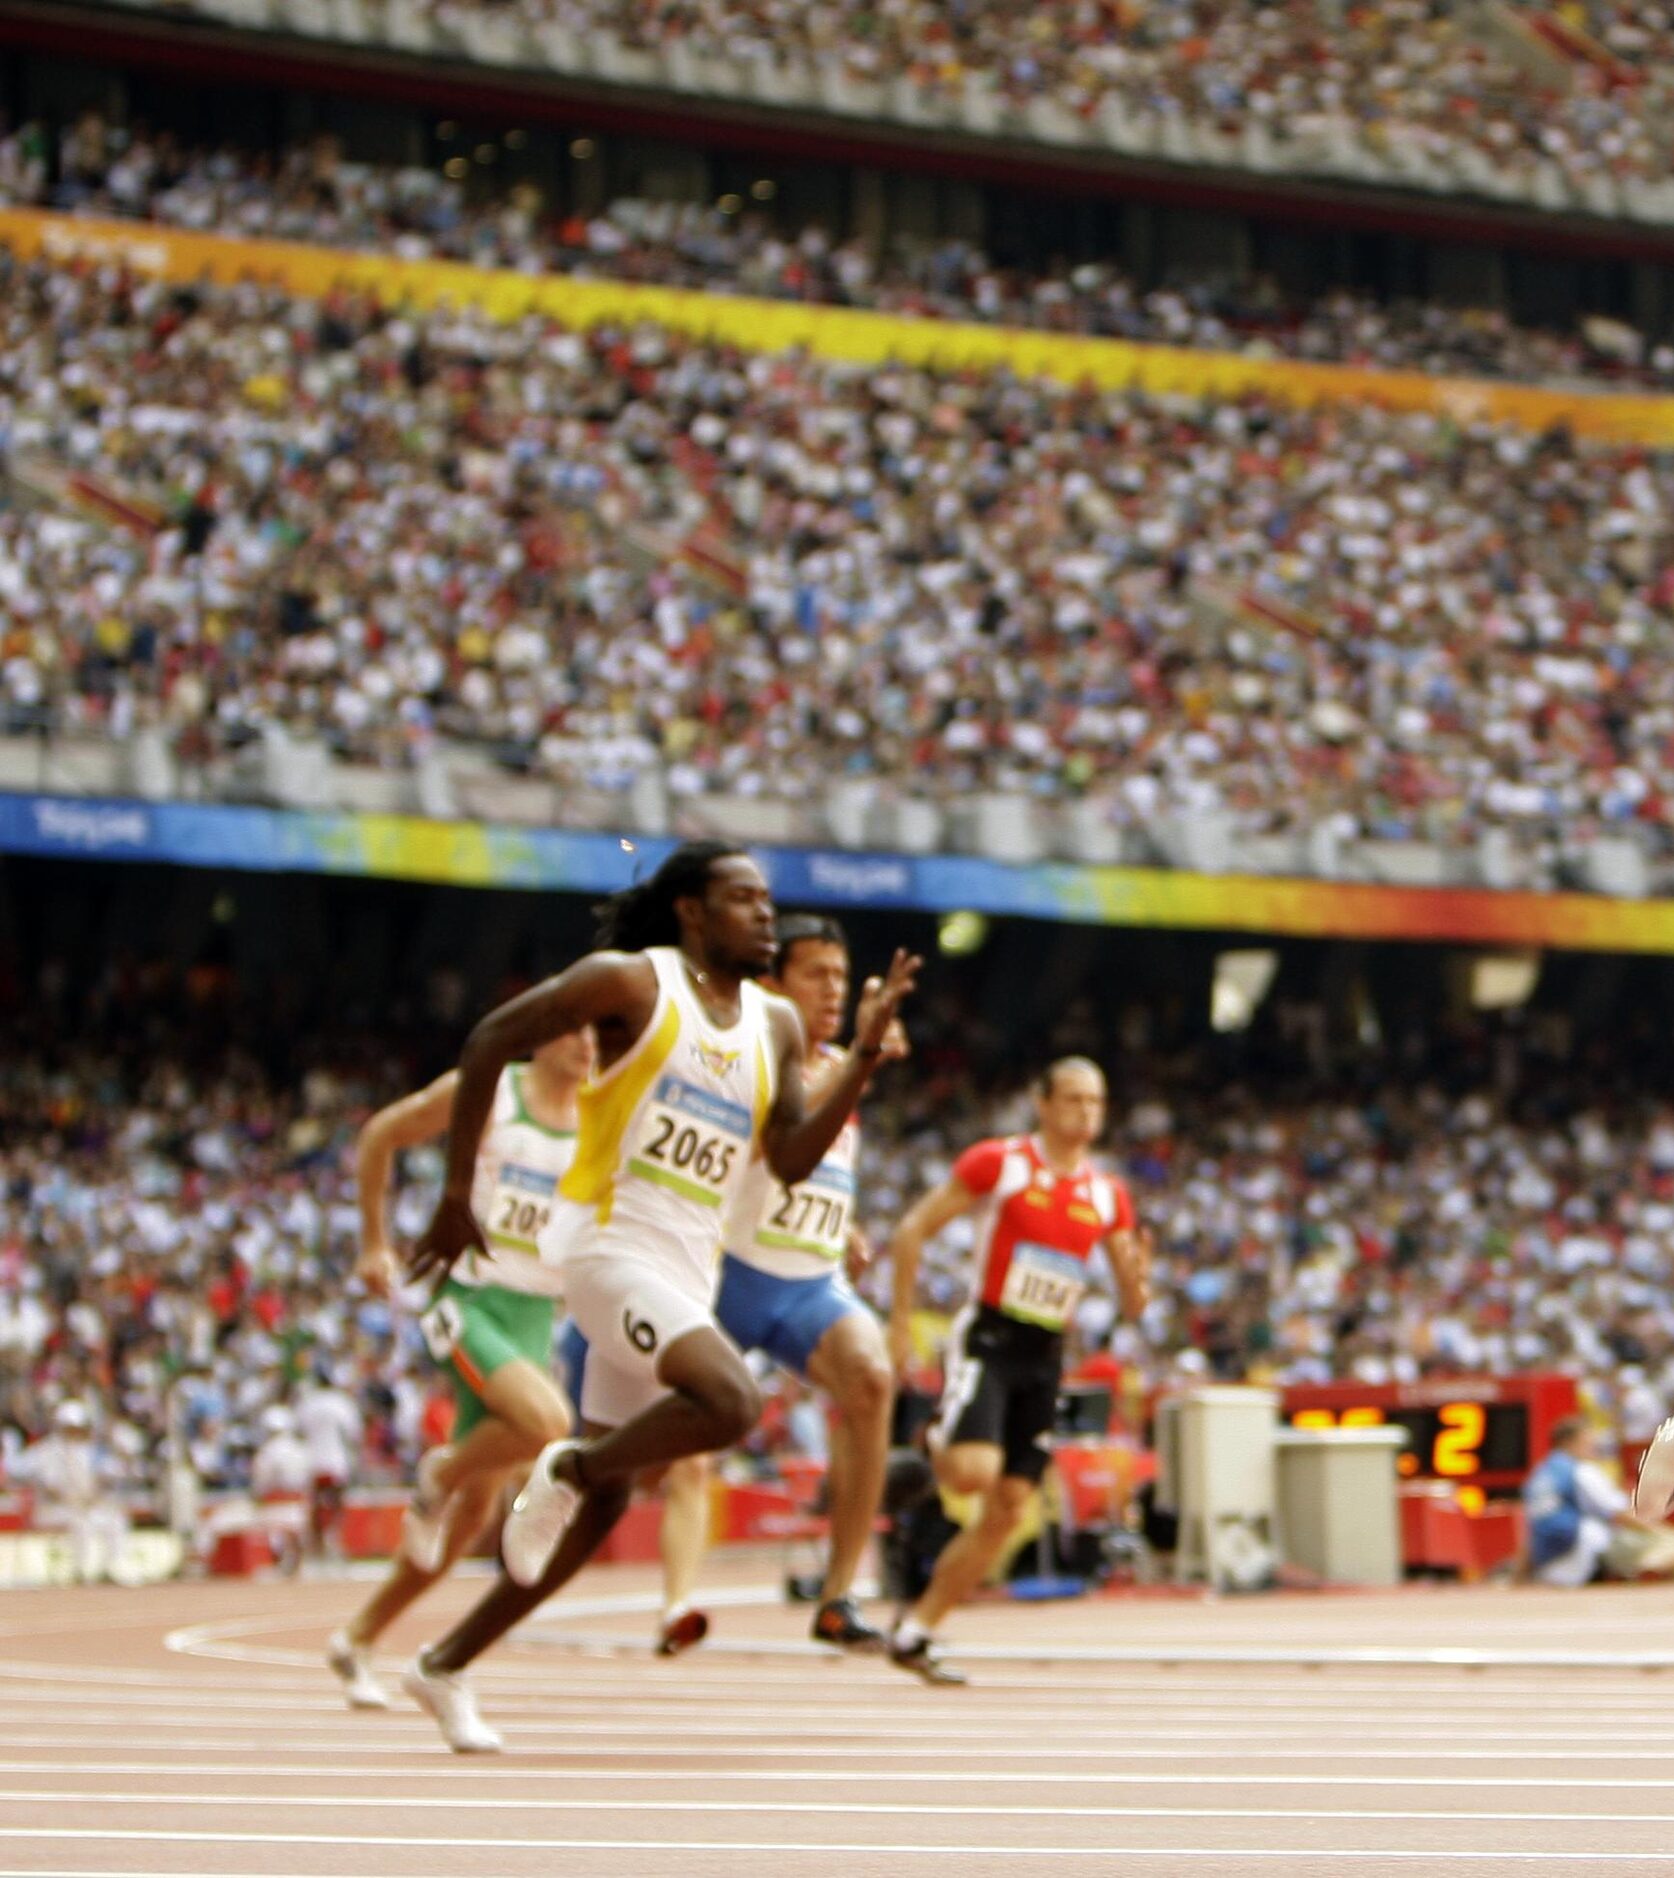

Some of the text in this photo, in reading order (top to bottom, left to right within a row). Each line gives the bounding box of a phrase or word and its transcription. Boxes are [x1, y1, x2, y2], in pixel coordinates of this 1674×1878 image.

[642, 1114, 737, 1184] 2065
[769, 1185, 844, 1239] 2770
[622, 1309, 657, 1354] 6
